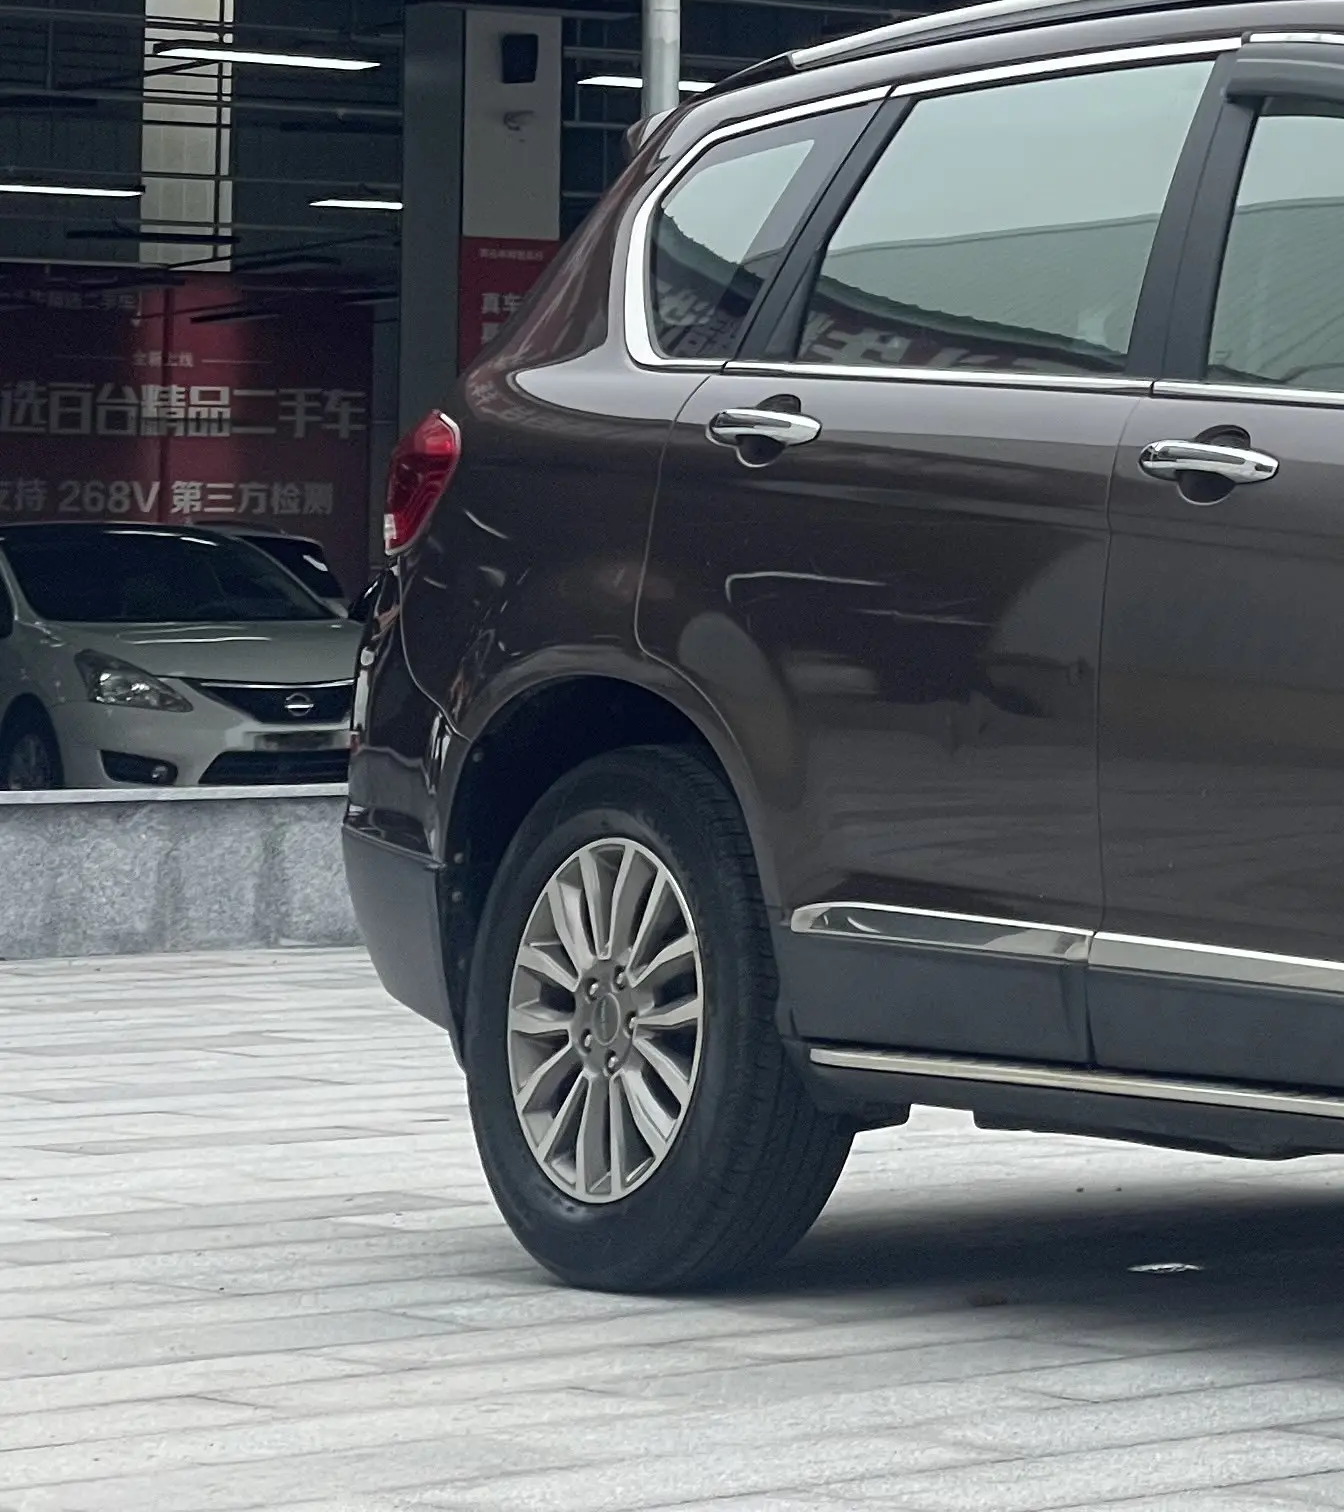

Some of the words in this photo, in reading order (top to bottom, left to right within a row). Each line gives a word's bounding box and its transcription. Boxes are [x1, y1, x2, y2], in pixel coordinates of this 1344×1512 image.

[58, 480, 160, 514] 268V
[170, 480, 335, 516] 第三方检测
